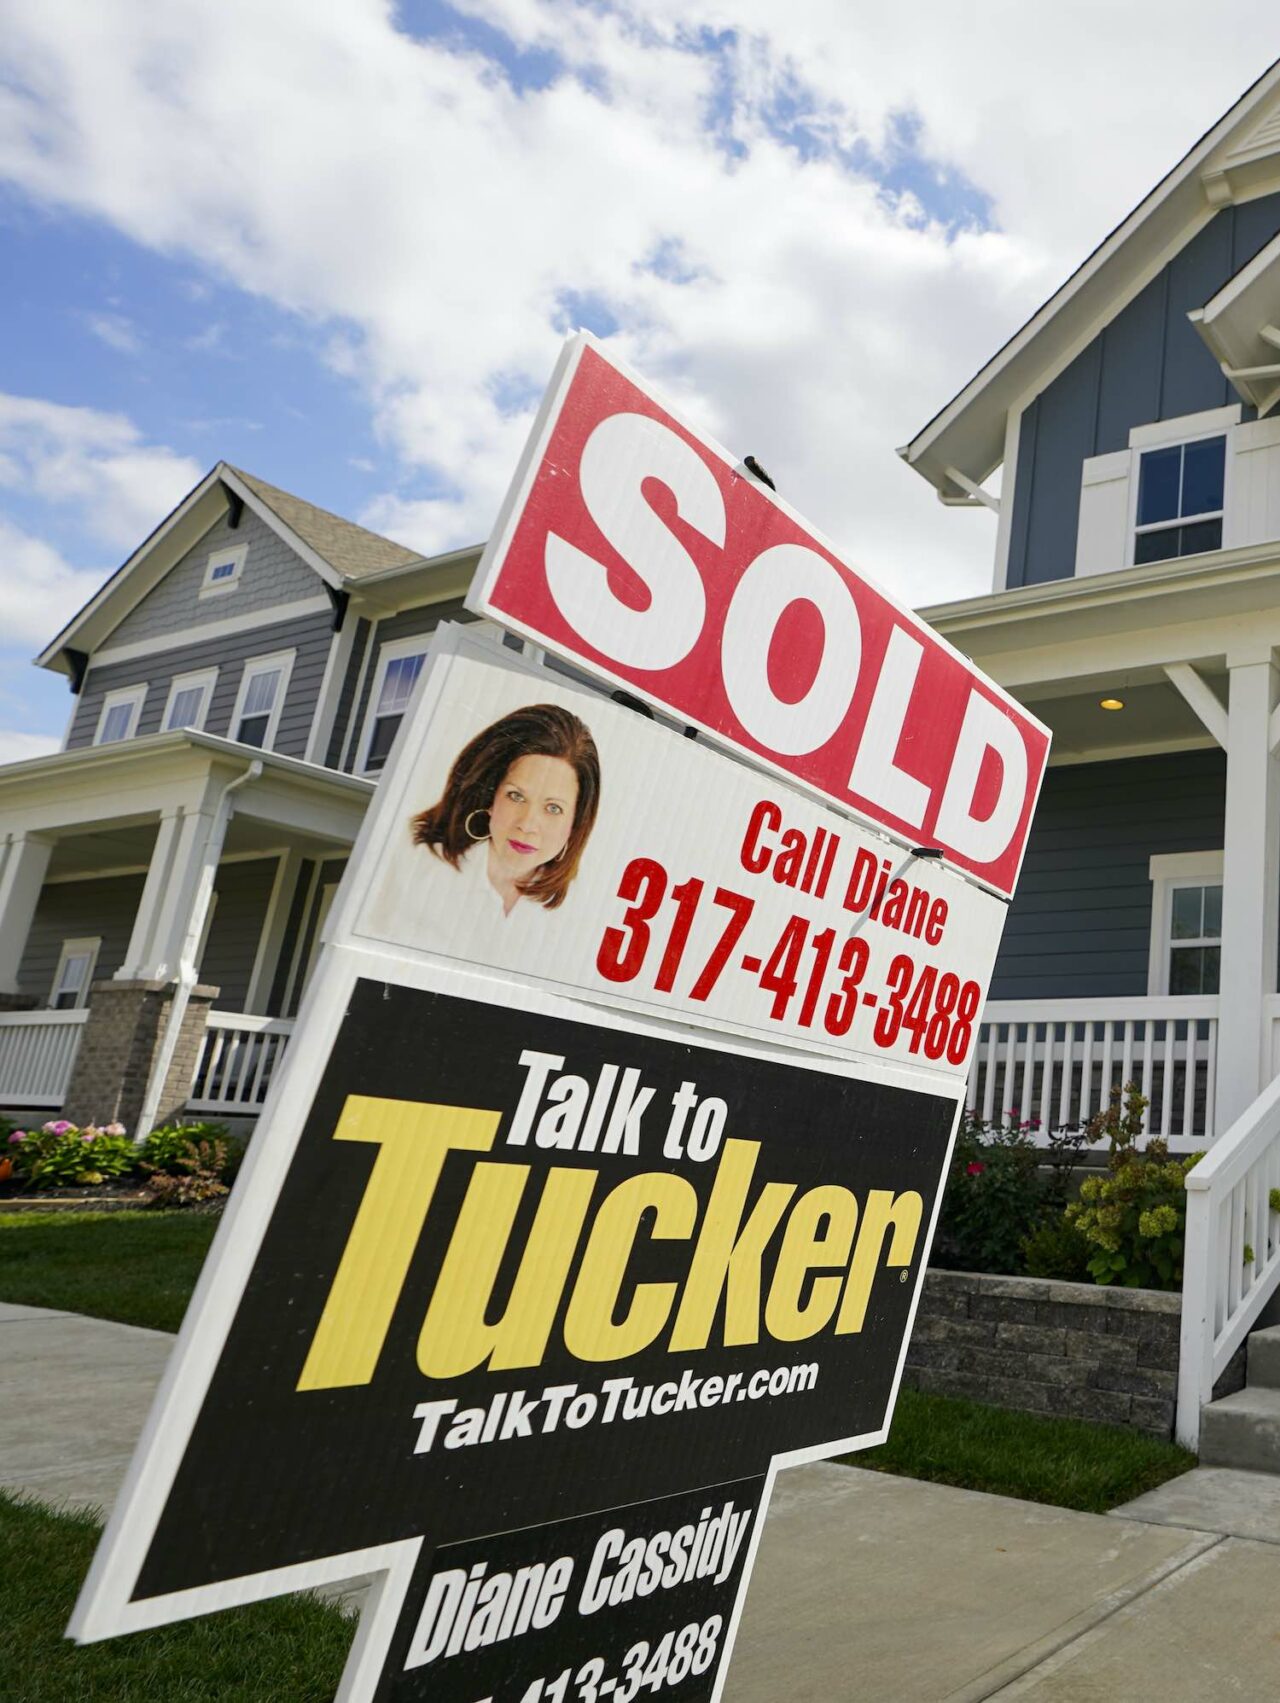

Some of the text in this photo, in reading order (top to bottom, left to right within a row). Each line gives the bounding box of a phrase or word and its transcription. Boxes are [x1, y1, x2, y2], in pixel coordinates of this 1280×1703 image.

[544, 412, 1028, 863] SOLD
[740, 800, 949, 946] Call Diane
[596, 857, 981, 1066] 317-413-3488
[505, 1049, 728, 1163] Talk to
[296, 1094, 924, 1392] Tucker
[412, 1362, 819, 1455] TalkToTucker.com
[403, 1500, 752, 1672] Diane Cassidy
